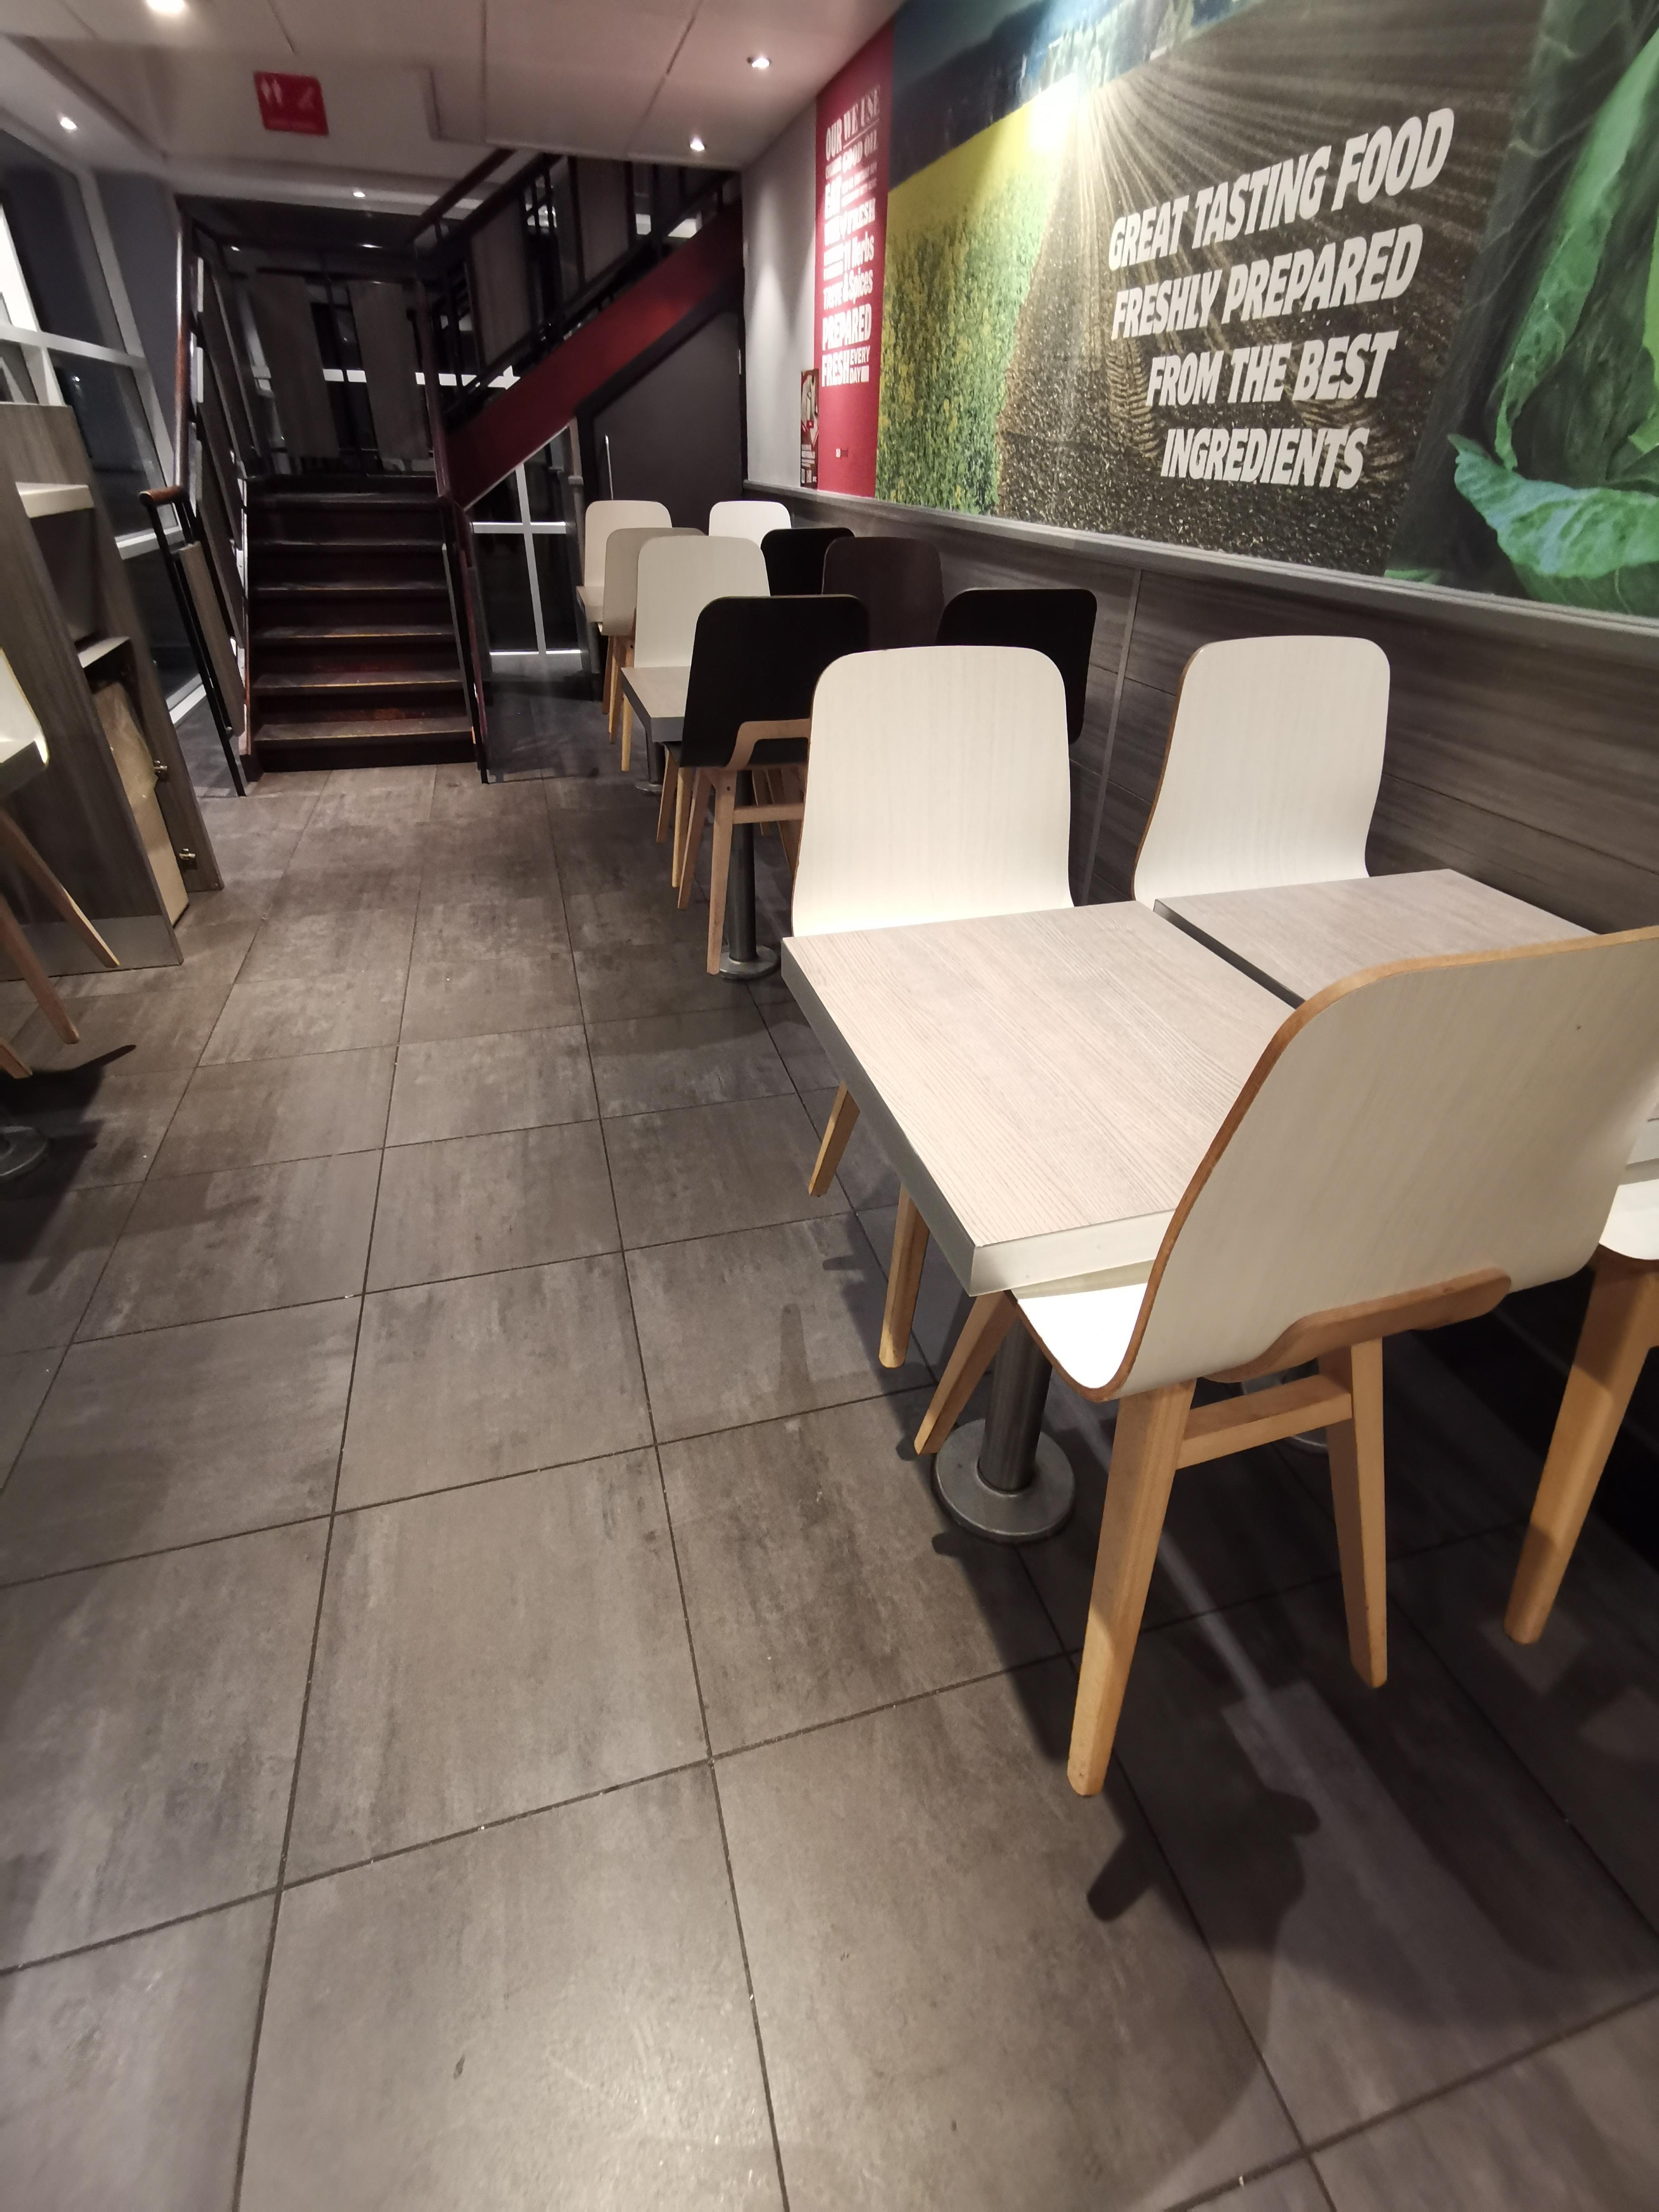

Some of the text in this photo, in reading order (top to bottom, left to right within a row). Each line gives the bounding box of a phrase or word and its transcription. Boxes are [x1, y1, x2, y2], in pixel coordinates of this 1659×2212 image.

[826, 118, 842, 161] OUR
[843, 103, 858, 140] WE
[842, 140, 863, 174] GOOD
[1108, 108, 1455, 271] GREAT TASTING FOOD
[847, 198, 876, 235] FRESH
[849, 267, 873, 305] Spices
[1111, 223, 1424, 340] FRESHLY PREPARED
[822, 303, 872, 351] PREPARED
[821, 349, 850, 387] FRESH
[850, 345, 871, 365] EVERY
[1146, 331, 1399, 407] FROM THE BEST
[849, 367, 861, 384] DAY
[1160, 428, 1370, 490] INGREDIENTS
